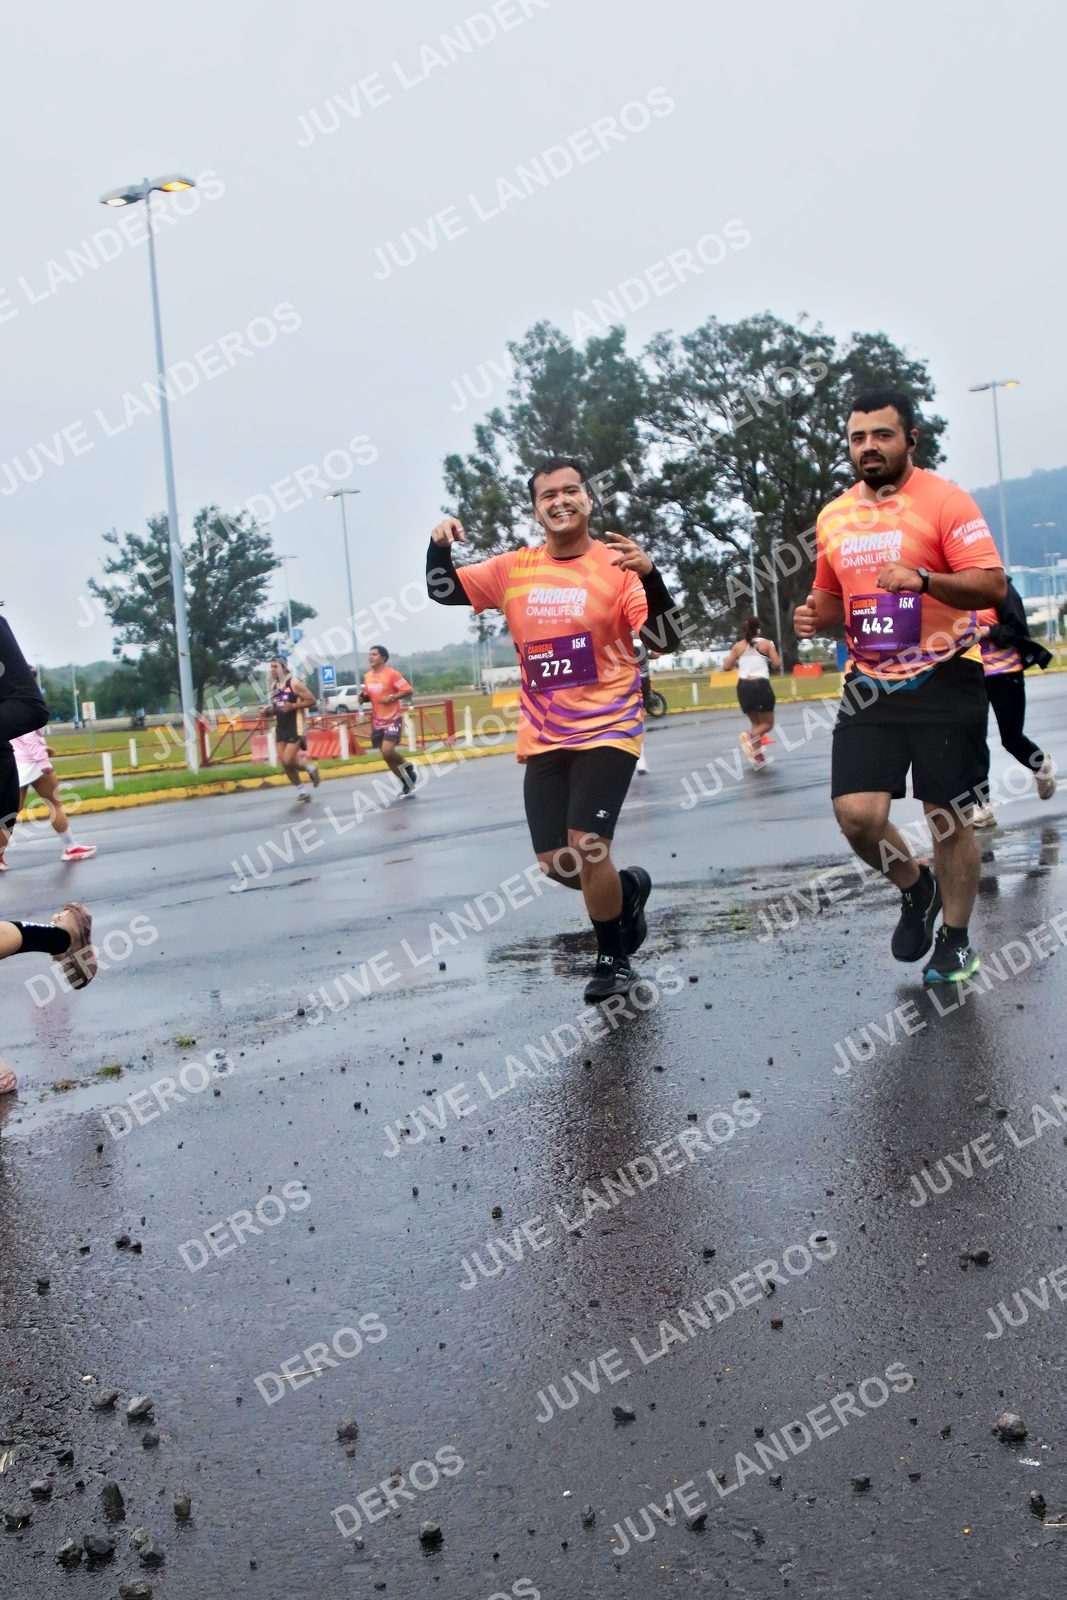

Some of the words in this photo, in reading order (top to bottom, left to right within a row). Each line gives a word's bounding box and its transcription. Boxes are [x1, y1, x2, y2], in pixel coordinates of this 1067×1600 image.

[841, 530, 903, 555] CARRERA
[528, 587, 587, 605] CARRERA
[898, 597, 915, 609] 15K
[861, 617, 894, 634] 442
[571, 637, 587, 649] 15K
[541, 659, 573, 678] 272
